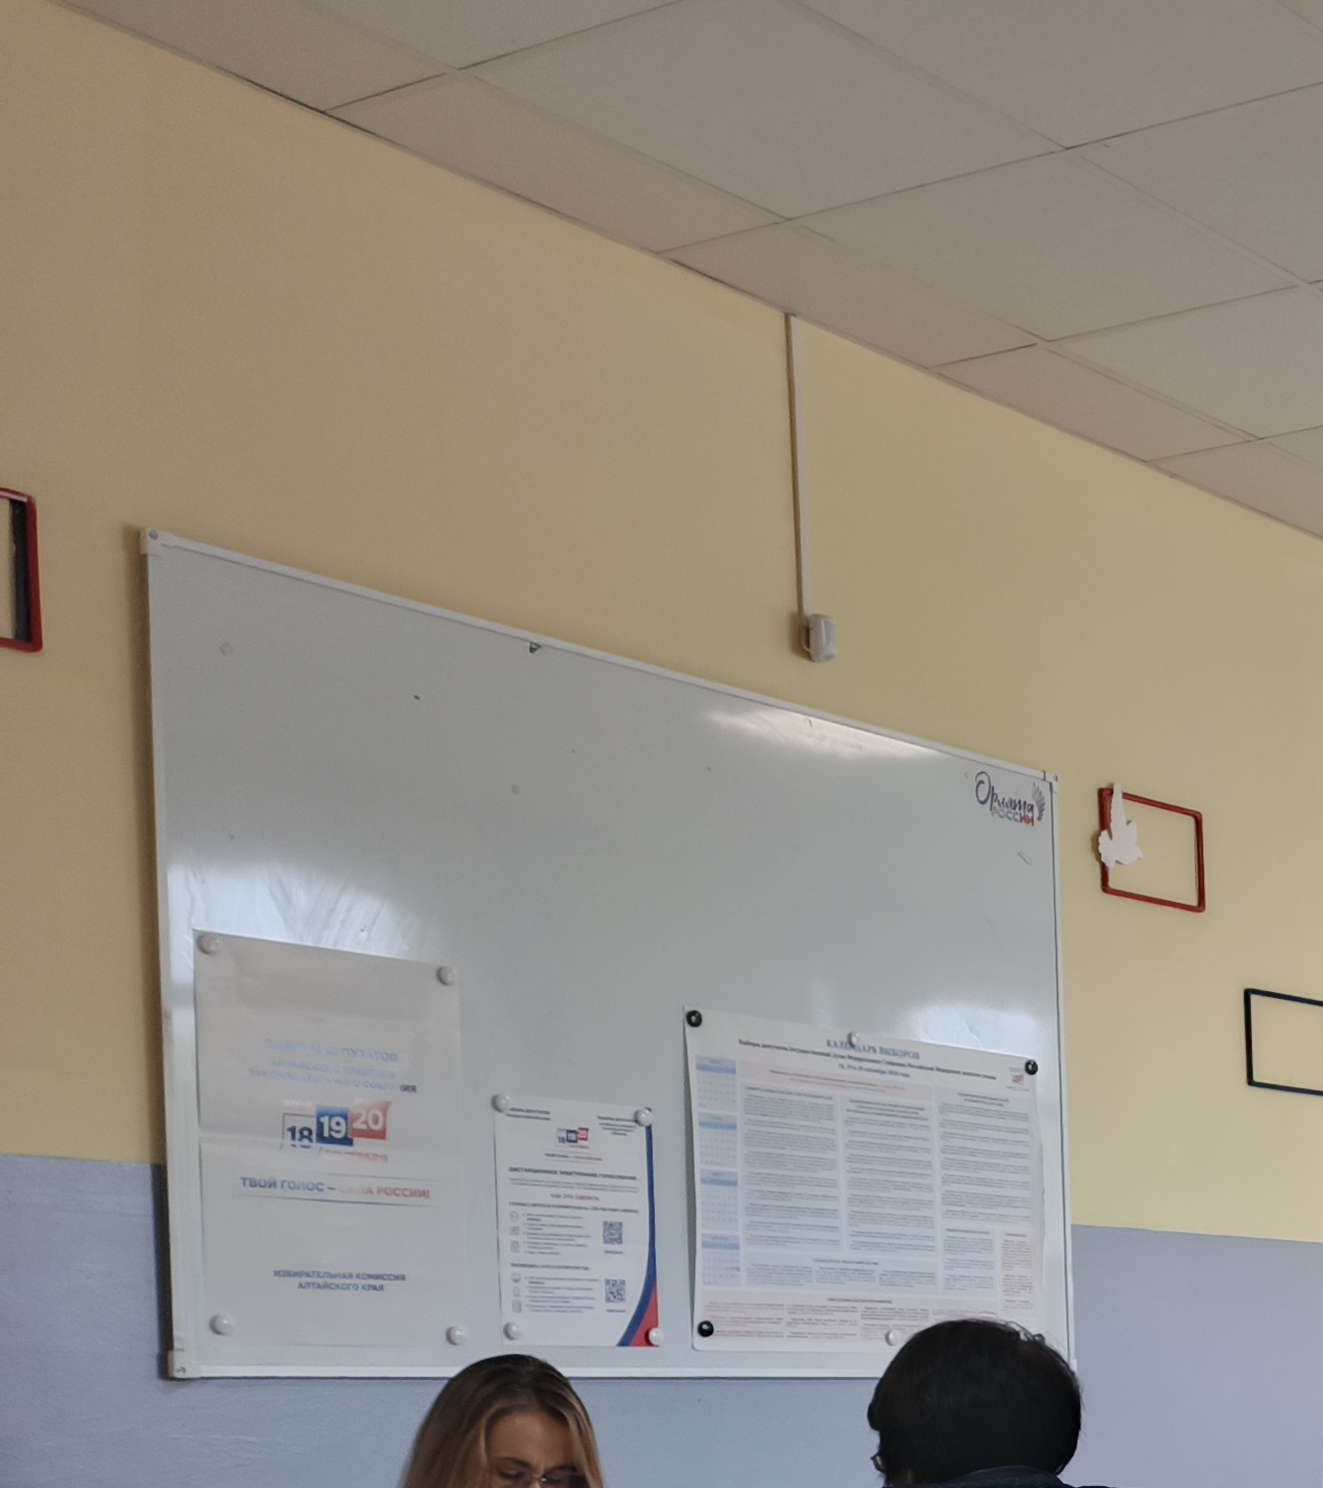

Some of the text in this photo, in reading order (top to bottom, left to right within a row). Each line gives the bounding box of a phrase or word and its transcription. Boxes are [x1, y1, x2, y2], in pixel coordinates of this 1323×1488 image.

[287, 1109, 384, 1149] 18 19 20
[240, 1176, 277, 1189] ТВОЙ
[280, 1179, 325, 1192] ГОЛОС
[355, 1272, 406, 1282] КОМИССИЯ
[361, 1284, 384, 1292] КРАЯ
